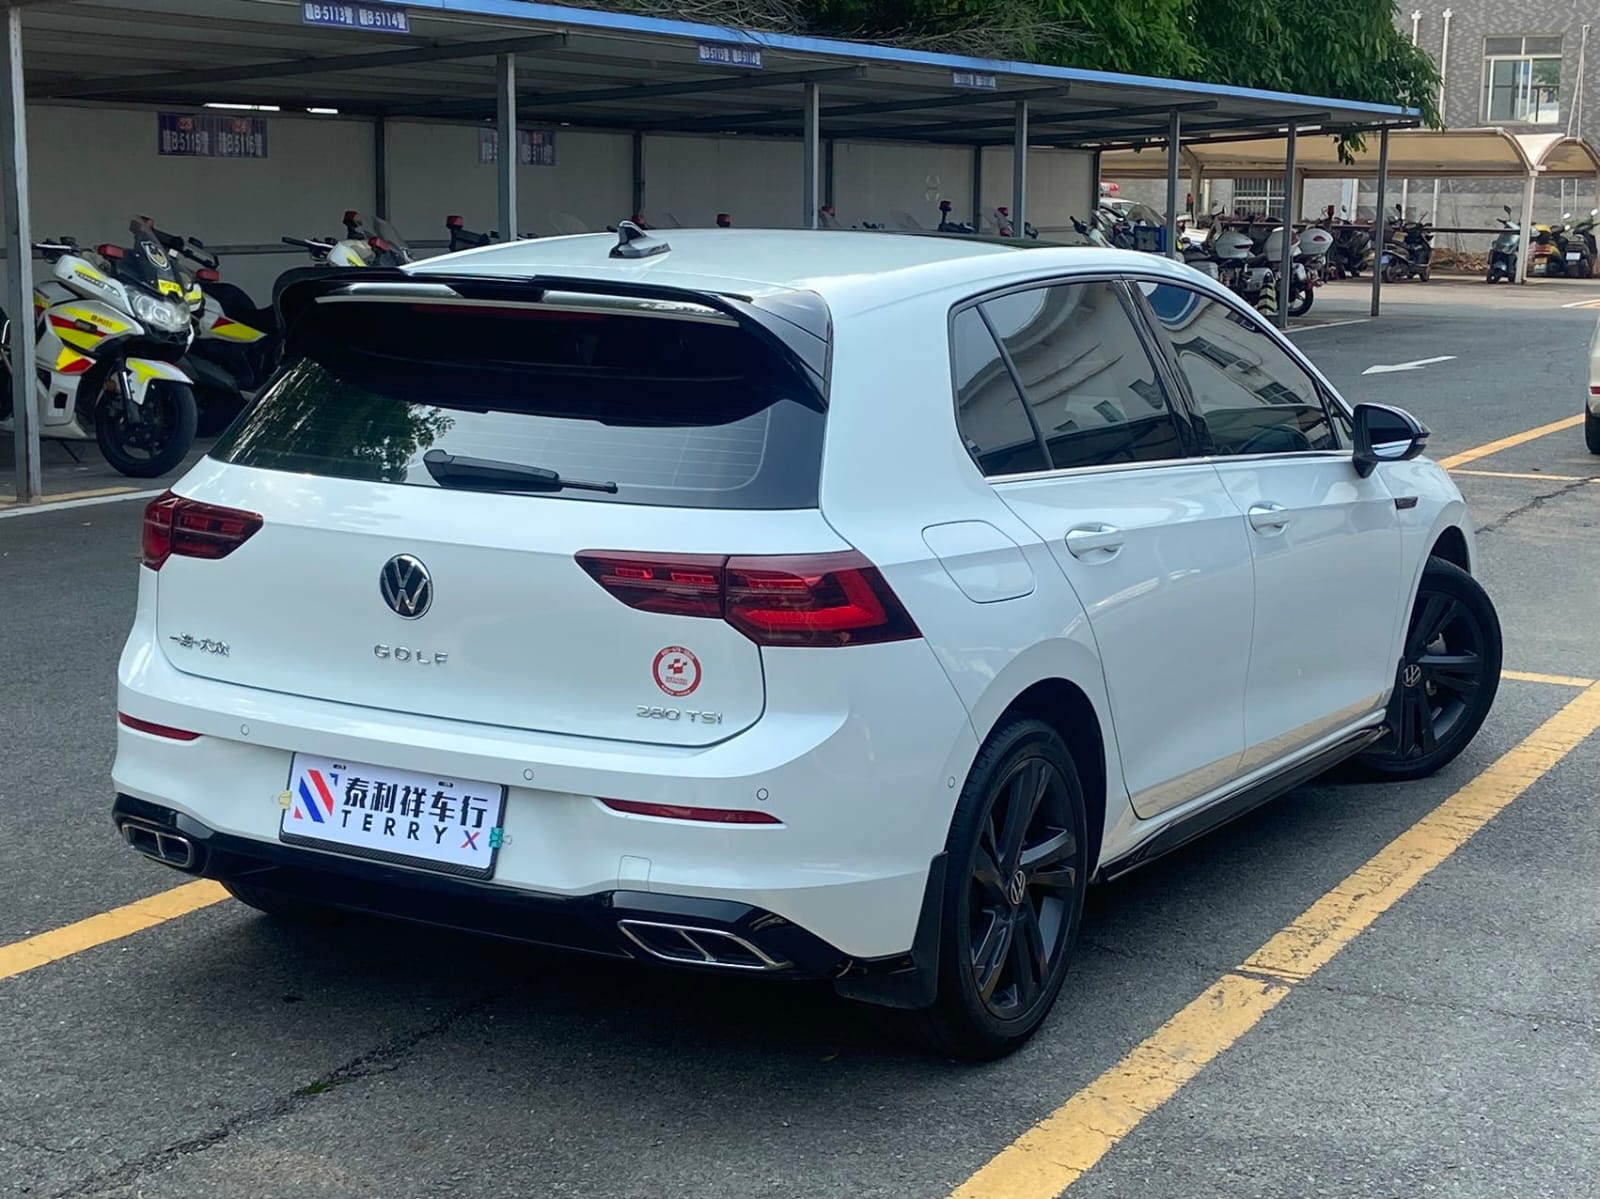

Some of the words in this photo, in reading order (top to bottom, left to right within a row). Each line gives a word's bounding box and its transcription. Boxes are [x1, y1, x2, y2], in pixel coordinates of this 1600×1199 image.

[374, 644, 448, 664] GOLF
[636, 704, 681, 721] 280
[343, 777, 489, 829] 泰利祥车行
